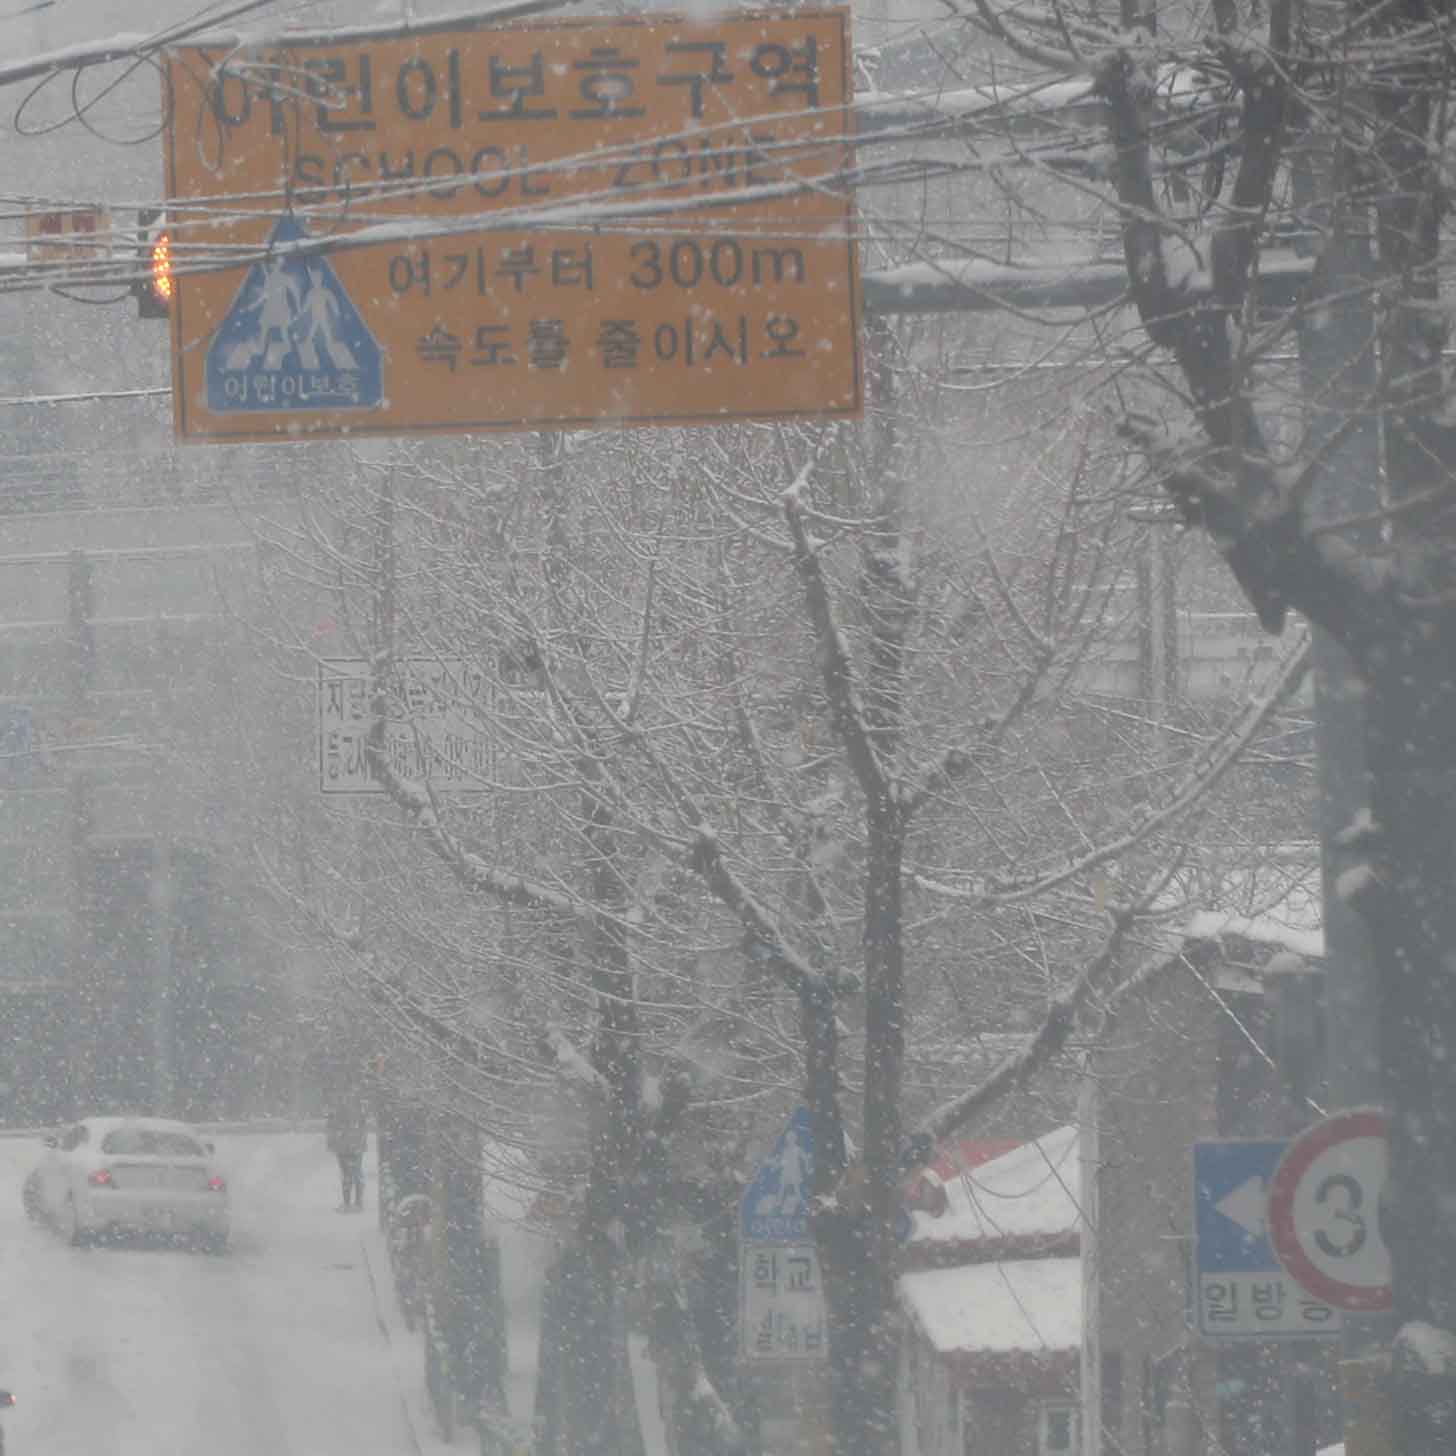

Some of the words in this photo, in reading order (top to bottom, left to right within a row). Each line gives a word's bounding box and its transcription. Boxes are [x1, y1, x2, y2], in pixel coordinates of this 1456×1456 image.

[216, 35, 821, 136] 어린이보호구역
[294, 145, 552, 207] SCHOOL
[389, 243, 594, 297] 여기부터
[629, 239, 807, 292] 300m
[415, 319, 571, 374] 속도를
[596, 316, 807, 370] 줄이시오
[1314, 1172, 1386, 1258] 3
